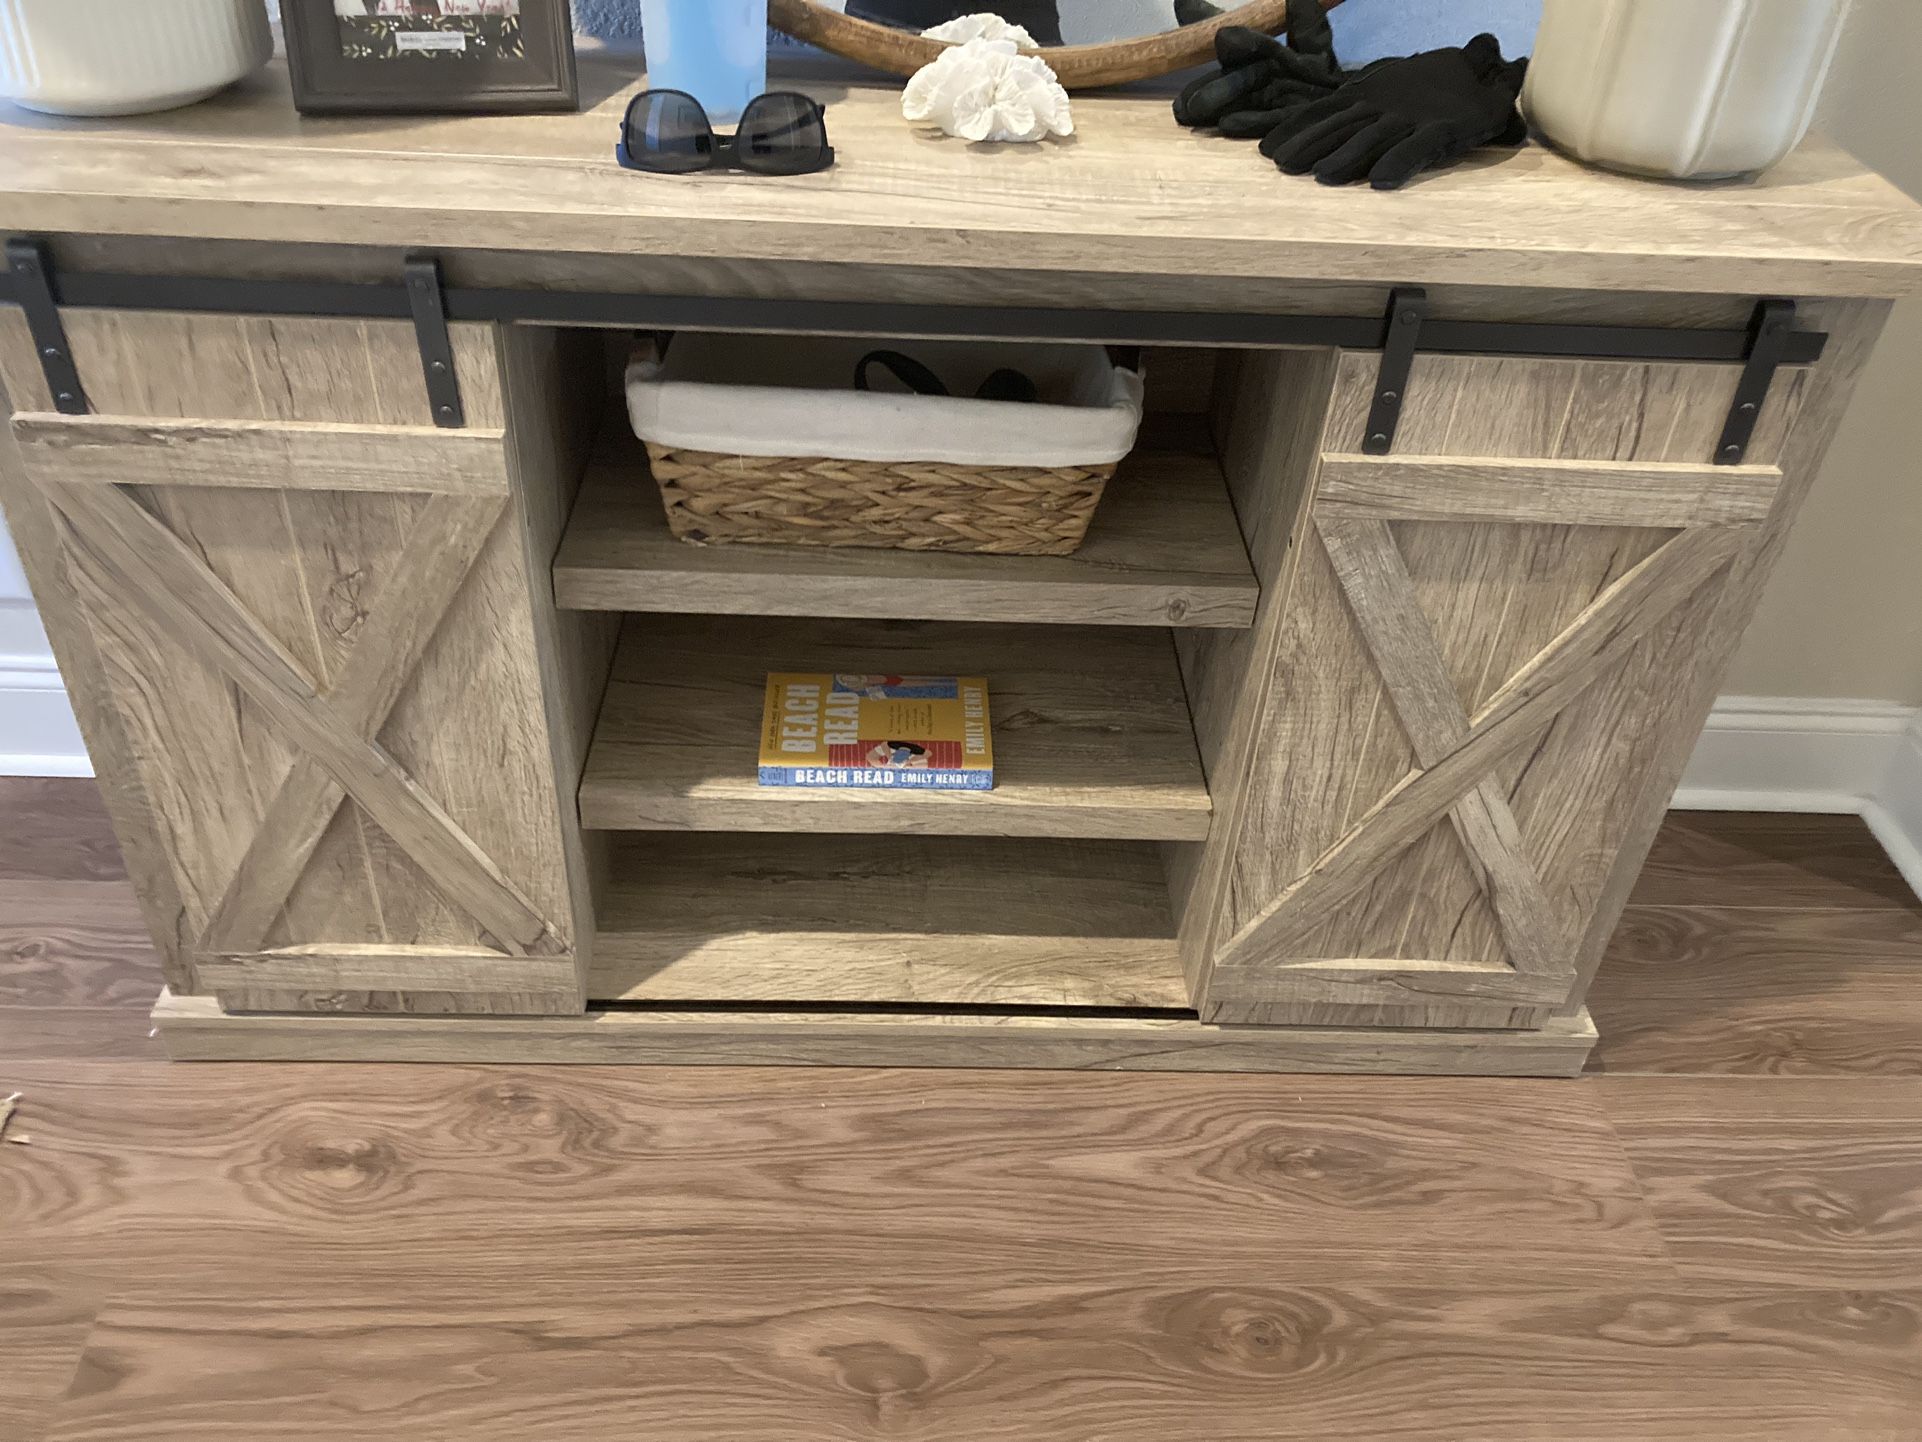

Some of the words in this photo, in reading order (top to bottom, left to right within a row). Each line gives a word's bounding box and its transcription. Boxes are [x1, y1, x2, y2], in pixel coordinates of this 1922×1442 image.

[781, 684, 820, 752] BEACH
[823, 691, 859, 745] READ
[963, 686, 983, 718] HENRY
[965, 720, 985, 755] EMILY
[795, 769, 848, 784] BEACH
[853, 770, 895, 785] READ
[901, 773, 932, 784] EMILY
[935, 774, 969, 785] HENRY
